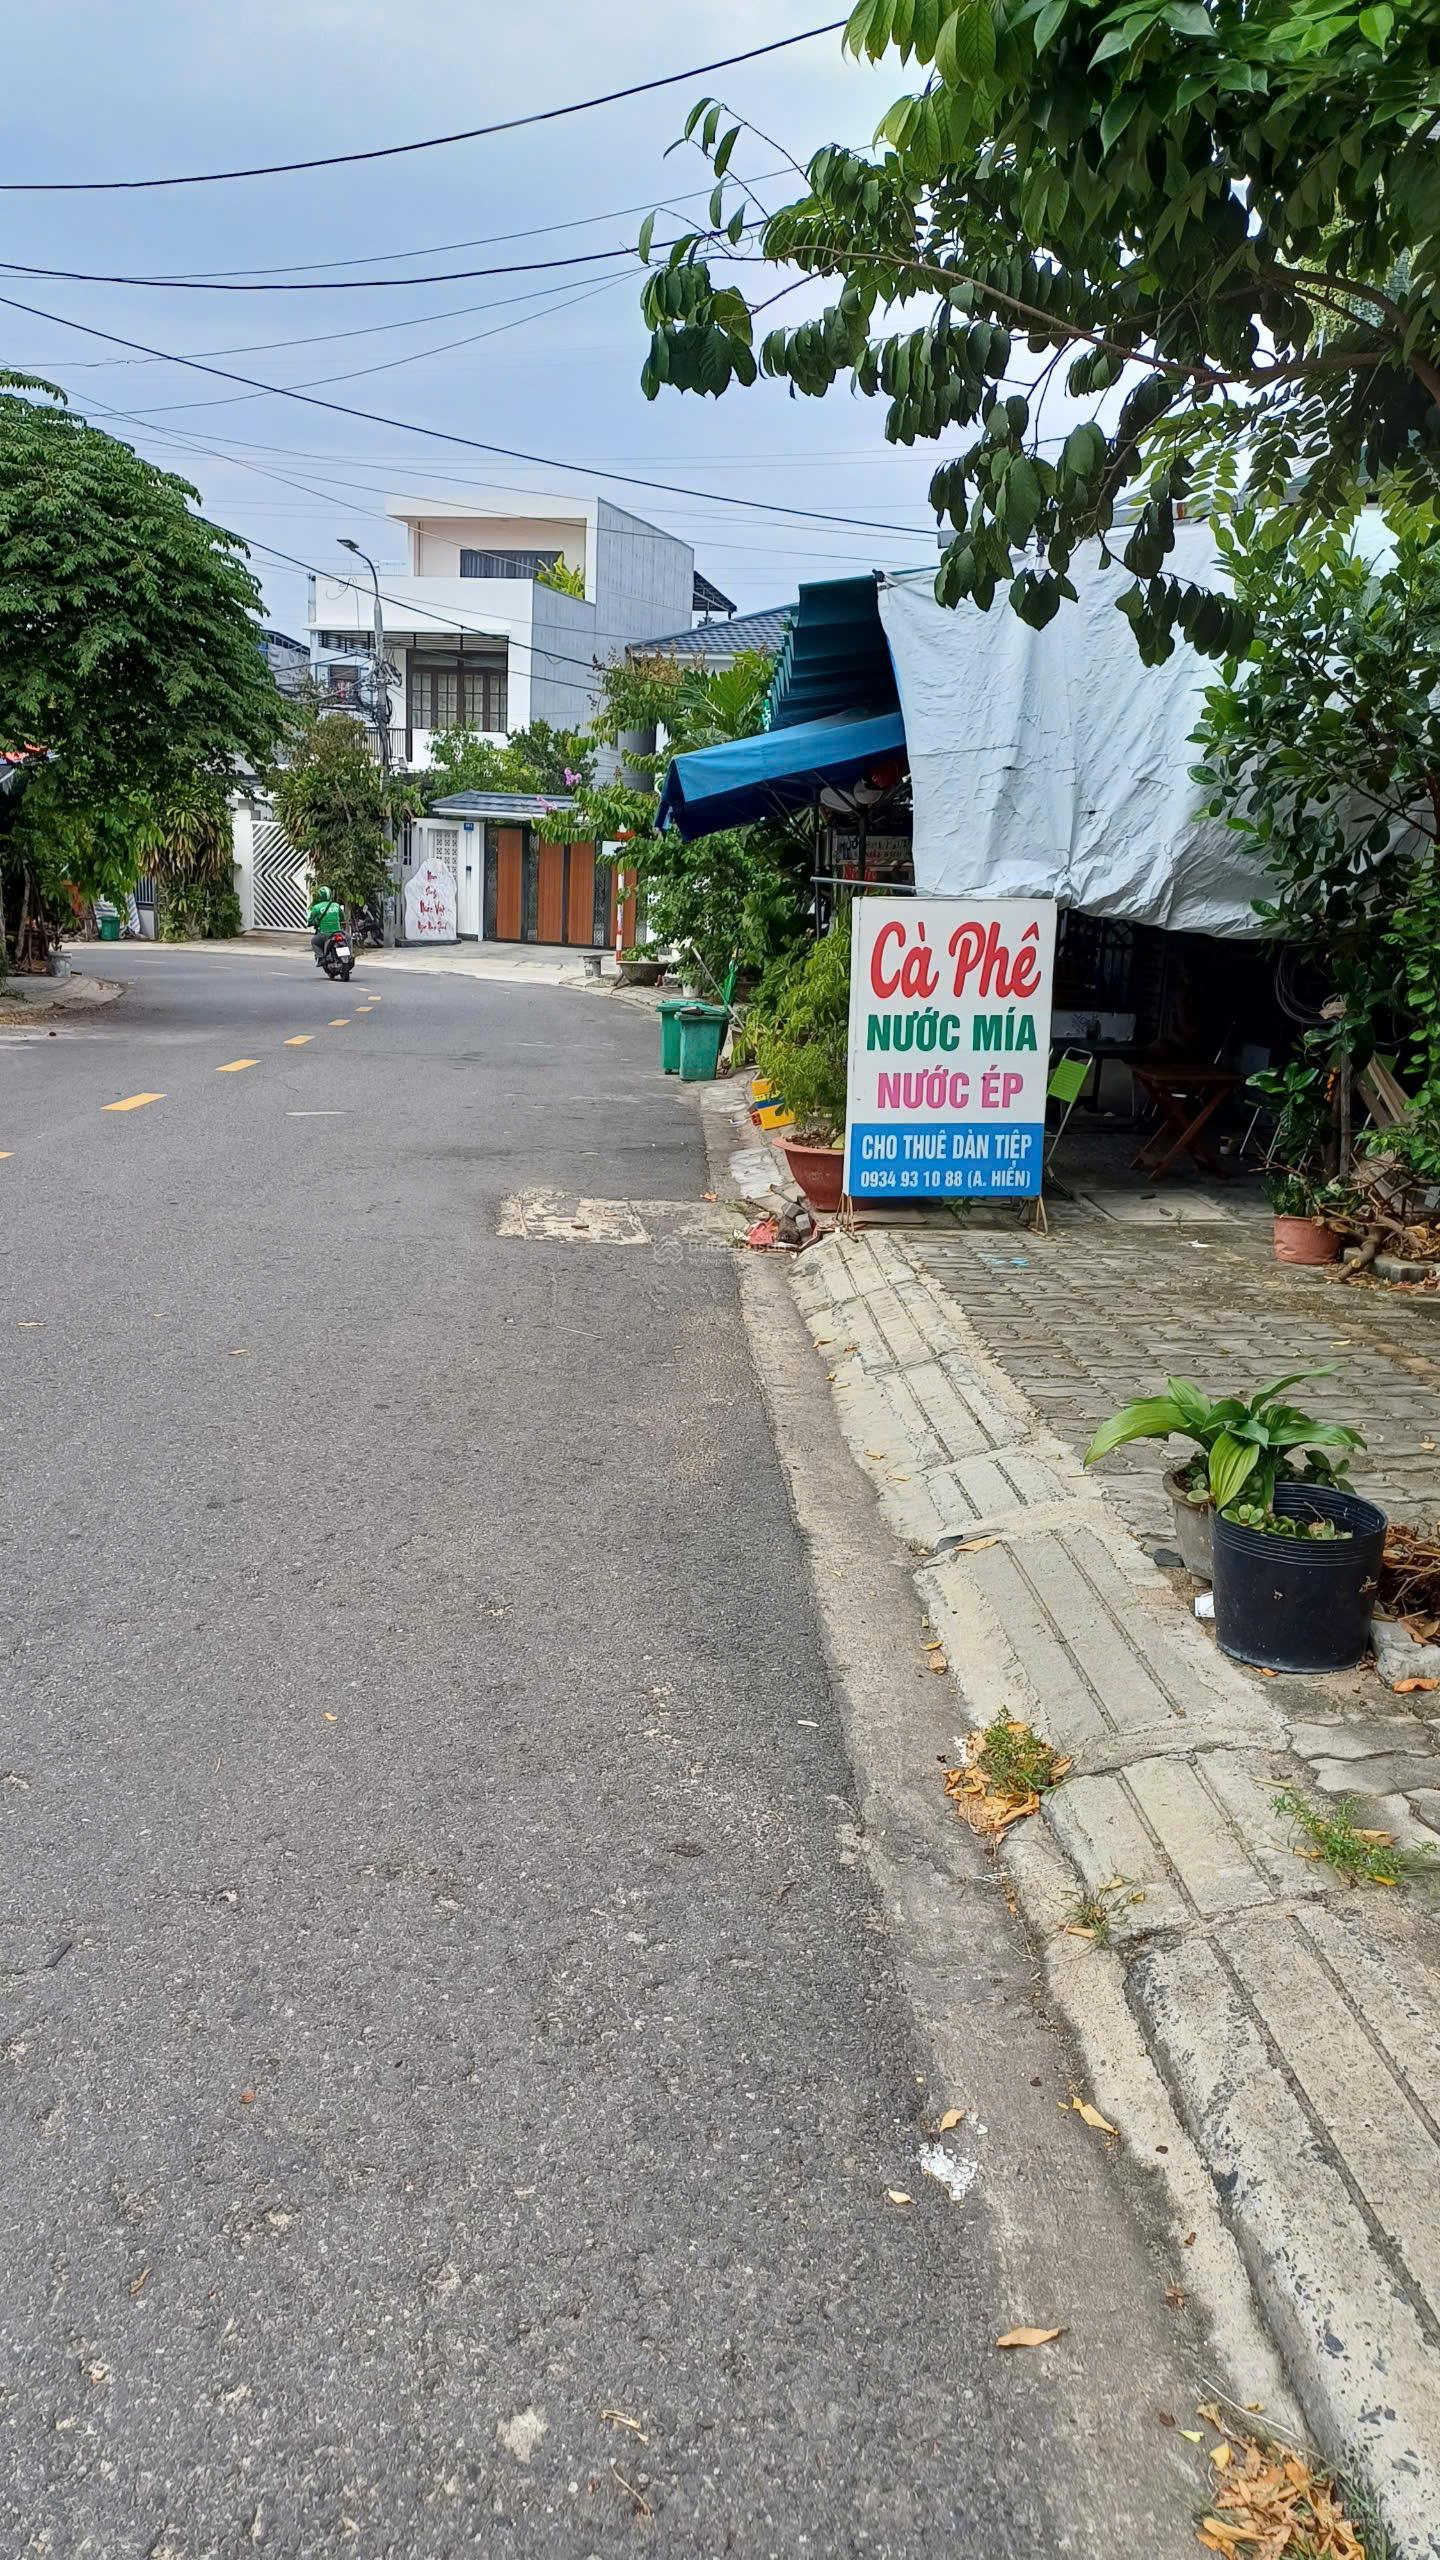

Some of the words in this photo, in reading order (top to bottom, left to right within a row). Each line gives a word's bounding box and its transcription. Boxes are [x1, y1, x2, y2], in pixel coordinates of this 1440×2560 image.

[870, 921, 939, 998] Cà
[948, 921, 1041, 998] Phê
[866, 1006, 960, 1051] NƯỚC
[972, 1006, 1038, 1051] MÍA
[877, 1065, 970, 1108] NƯỚC
[981, 1065, 1024, 1108] ÉP
[862, 1134, 897, 1160] CHO
[903, 1129, 946, 1159] THUÊ
[952, 1129, 989, 1159] DÀN
[861, 1171, 896, 1187] 0934
[901, 1171, 918, 1187] 93
[924, 1171, 941, 1187] 10
[945, 1171, 963, 1187] 88
[968, 1170, 987, 1188] (A.
